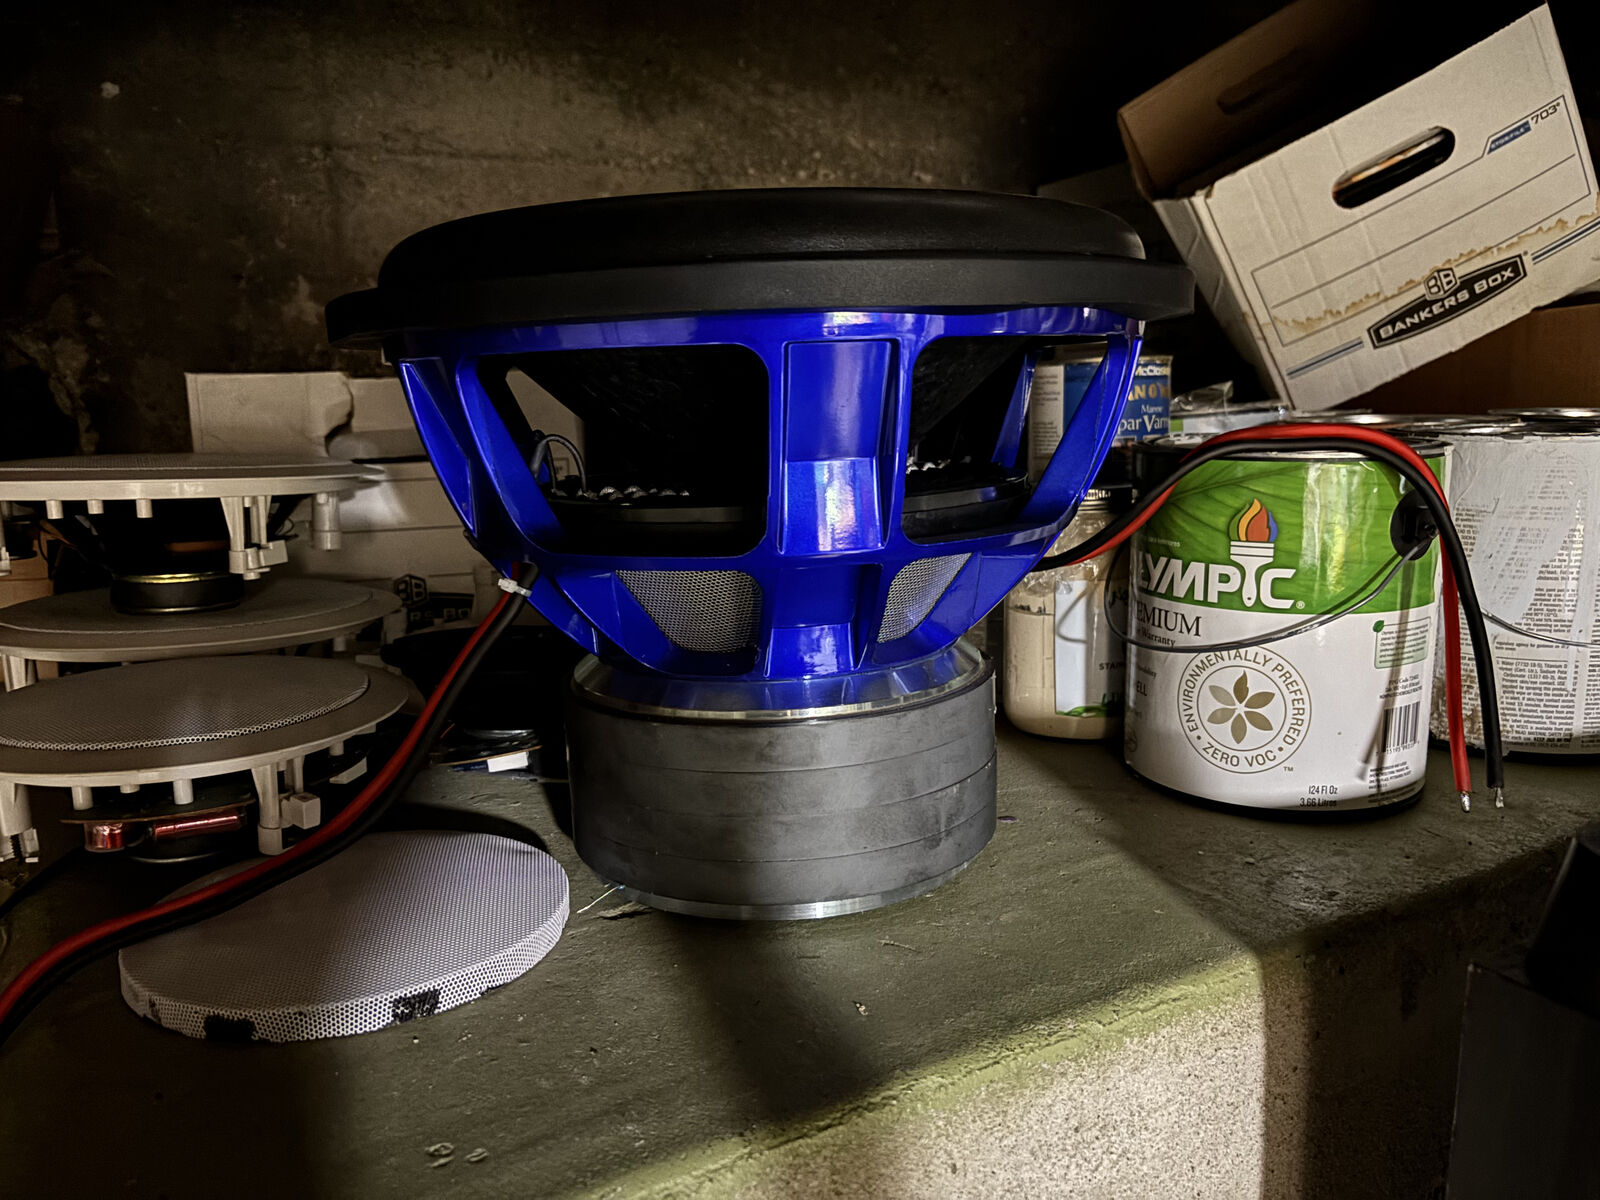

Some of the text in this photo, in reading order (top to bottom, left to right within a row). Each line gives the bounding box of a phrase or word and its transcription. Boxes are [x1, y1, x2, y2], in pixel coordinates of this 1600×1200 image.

[1379, 266, 1515, 339] BANKERS BOX
[1117, 418, 1143, 435] par
[1138, 542, 1297, 609] LYMPIC
[1137, 600, 1202, 637] EMIUM
[1183, 650, 1305, 746] ENVIRONMENTALLY PREFERRED
[1202, 742, 1277, 768] ZERO VOC
[1300, 797, 1317, 807] 3.66
[1308, 785, 1320, 795] 124
[1329, 785, 1338, 795] Oz
